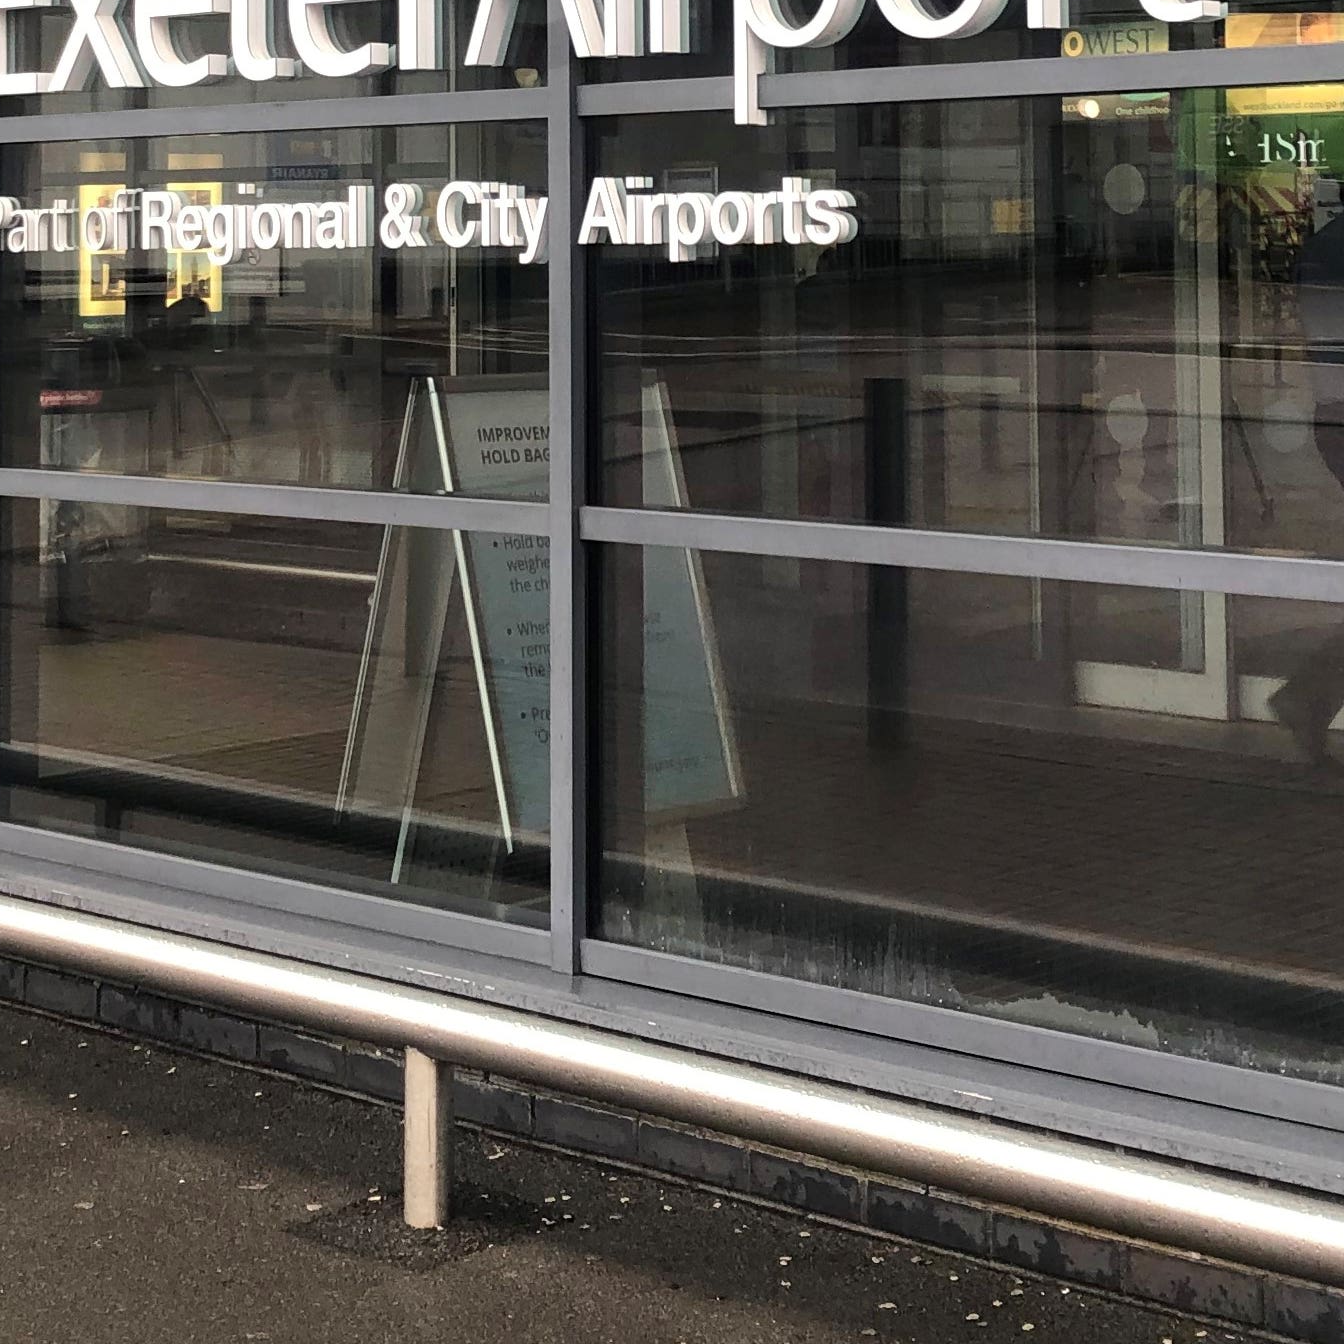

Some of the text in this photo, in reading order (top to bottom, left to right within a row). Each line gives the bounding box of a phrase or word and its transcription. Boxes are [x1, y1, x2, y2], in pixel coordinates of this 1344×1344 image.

[83, 188, 140, 252] of
[142, 184, 372, 266] Regional
[379, 182, 426, 250] &
[436, 180, 548, 265] City
[578, 176, 856, 263] Airports
[480, 447, 550, 464] HOLD BAG
[503, 535, 534, 550] Hold
[510, 576, 532, 593] the
[523, 658, 546, 677] the
